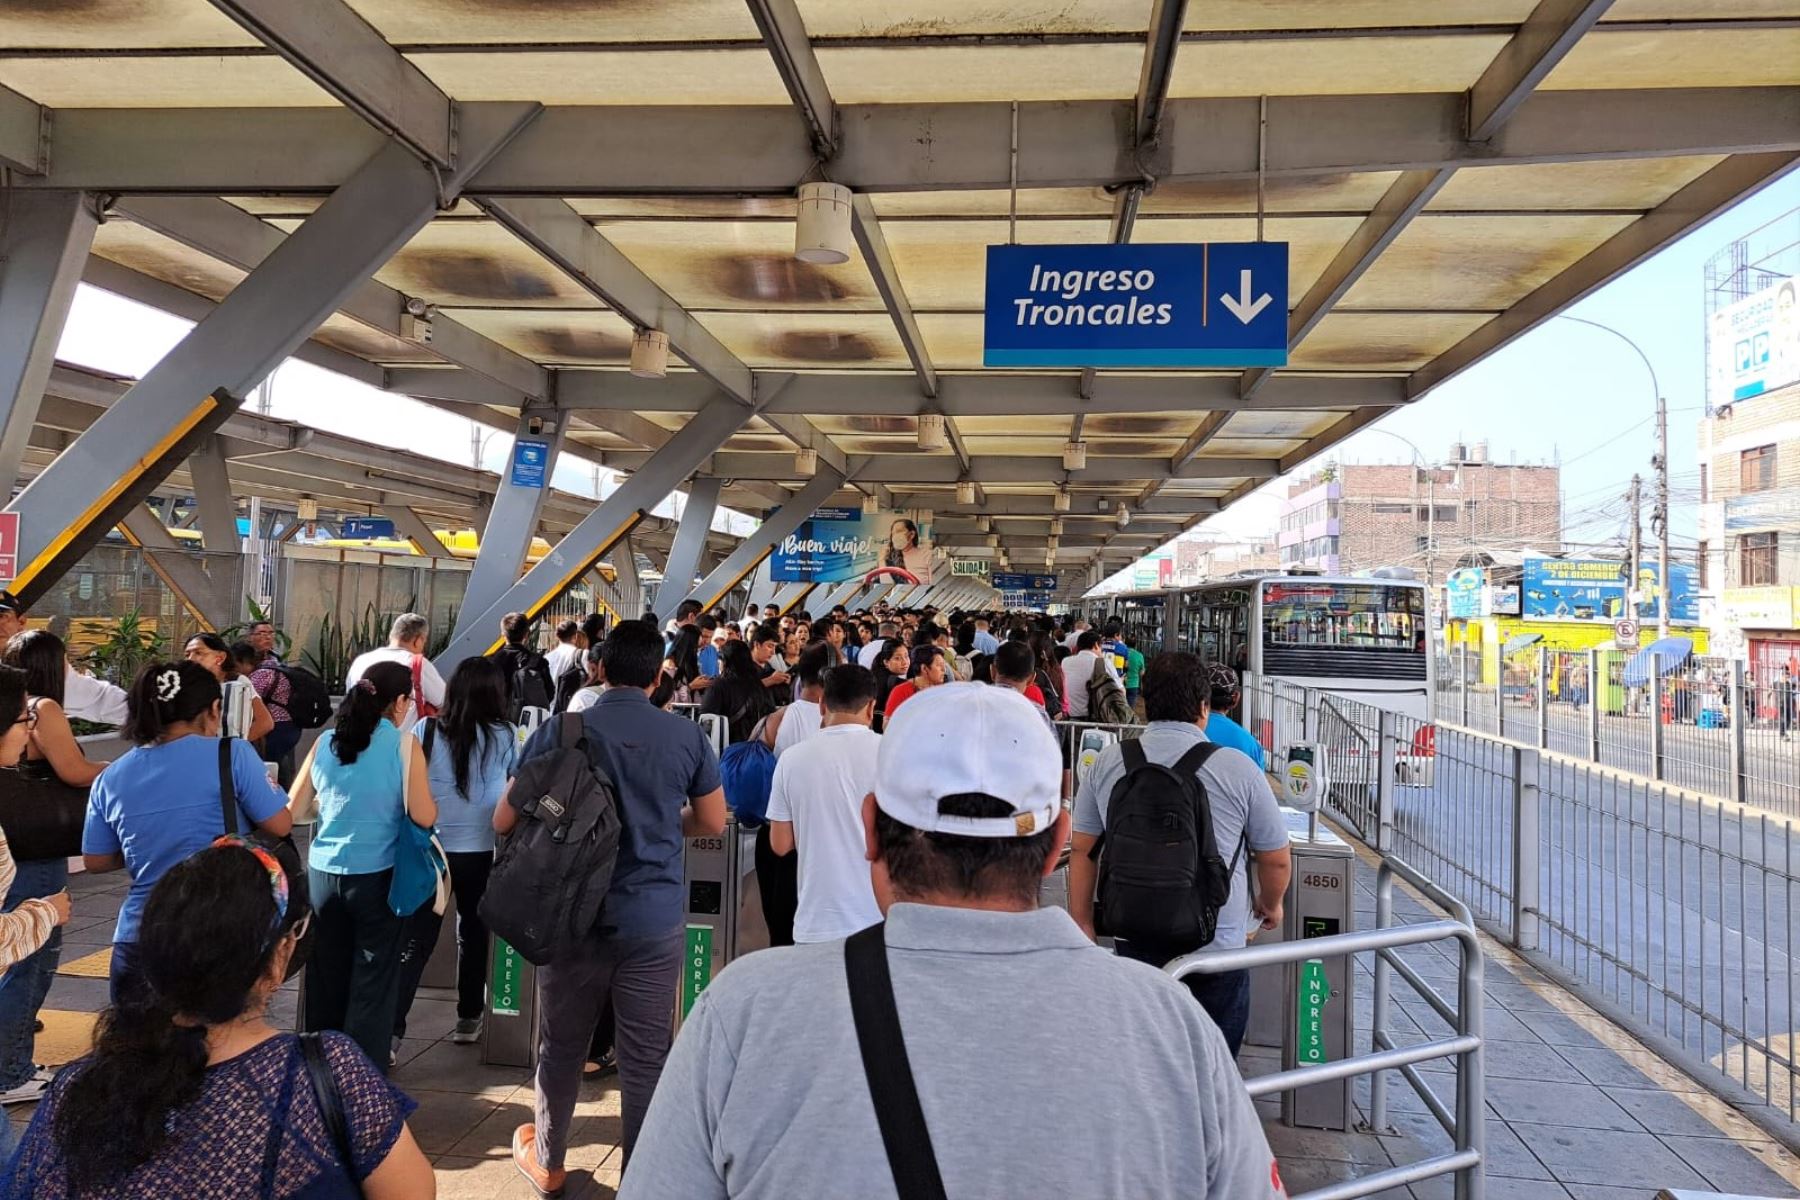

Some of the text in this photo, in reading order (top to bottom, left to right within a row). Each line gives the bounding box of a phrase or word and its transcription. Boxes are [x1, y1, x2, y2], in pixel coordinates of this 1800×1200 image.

[1029, 264, 1155, 300] Ingreso
[1013, 296, 1172, 326] Troncales
[778, 533, 873, 560] ¡Buen viaje!
[953, 561, 979, 574] SALIDA
[692, 838, 722, 851] 4853
[1303, 874, 1338, 888] 4850
[502, 945, 515, 1006] GRESO
[693, 931, 704, 1000] INGRE
[1309, 967, 1320, 1059] INGRESO
